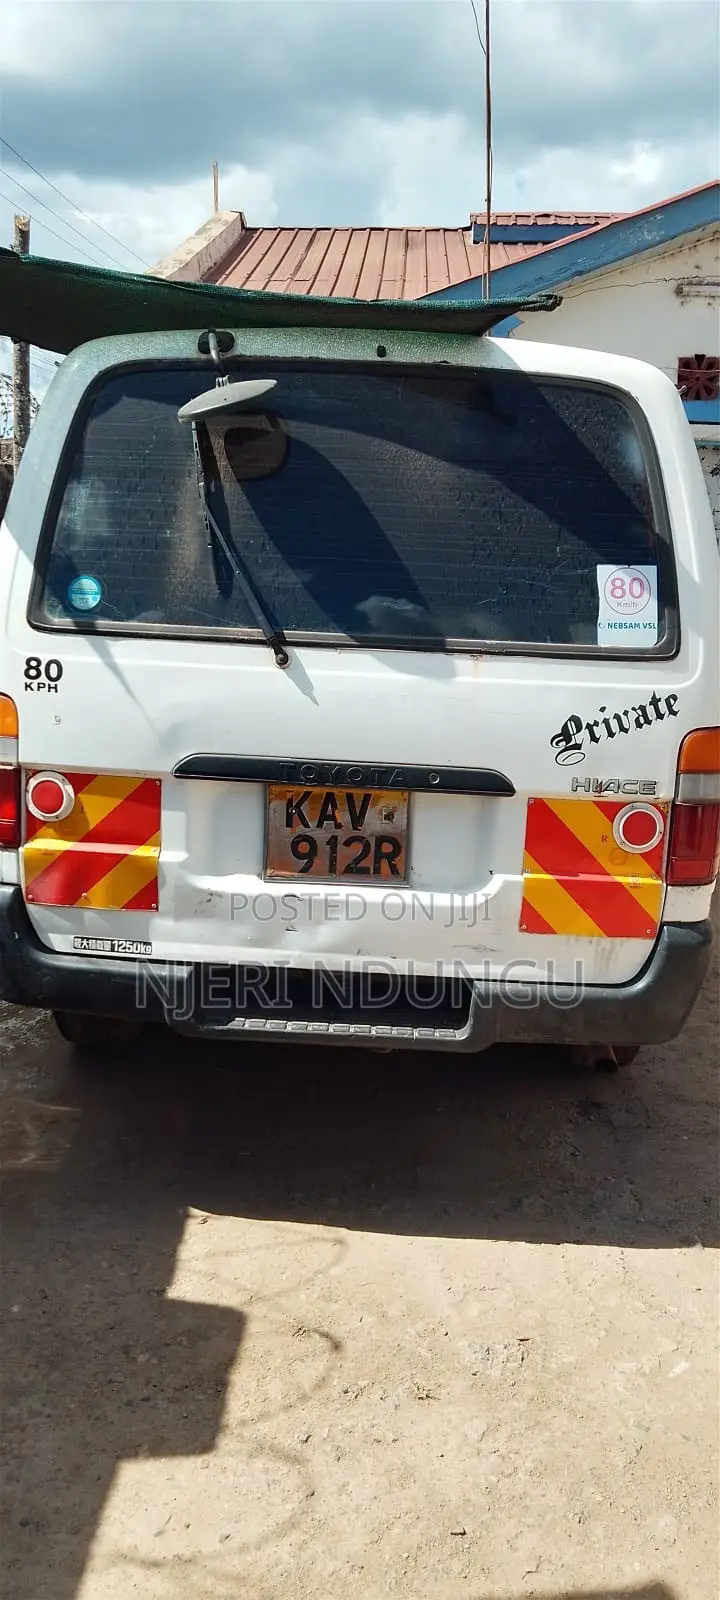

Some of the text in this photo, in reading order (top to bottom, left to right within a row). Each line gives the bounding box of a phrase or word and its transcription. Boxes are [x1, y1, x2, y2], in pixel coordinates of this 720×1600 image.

[610, 577, 645, 599] 80
[24, 656, 63, 682] 80
[24, 682, 58, 693] KPH
[550, 690, 680, 766] Private
[279, 762, 405, 785] TOYOTA
[571, 777, 658, 795] HIACE
[285, 790, 373, 831] KAV
[290, 834, 402, 875] 912R
[112, 940, 152, 954] 1250kg
